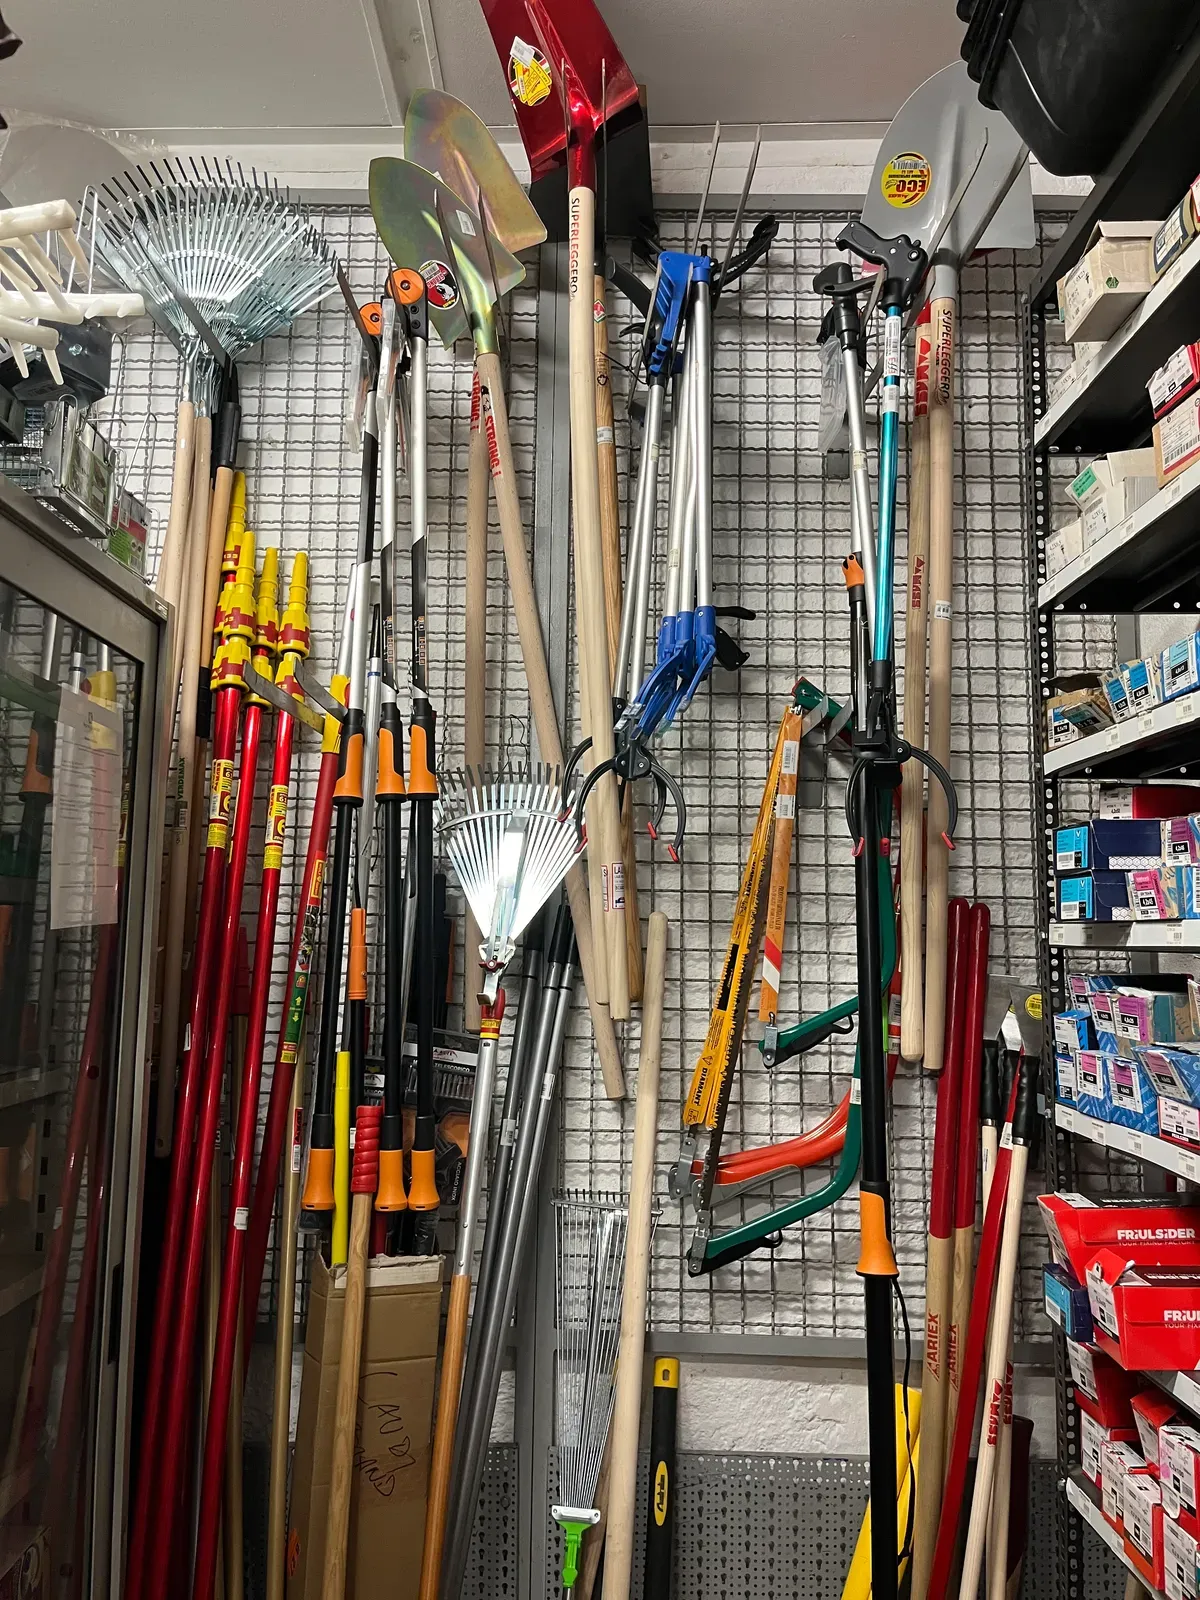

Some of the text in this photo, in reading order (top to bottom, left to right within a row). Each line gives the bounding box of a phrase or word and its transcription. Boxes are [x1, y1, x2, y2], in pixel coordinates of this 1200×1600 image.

[896, 179, 926, 193] ECO
[570, 197, 580, 293] SUPERLEGGERO
[940, 308, 953, 399] SUPERLEGGERO
[484, 415, 500, 469] STRONG
[176, 755, 186, 801] VERDEMAX
[434, 1062, 470, 1072] TELESCOPICO
[693, 1066, 708, 1107] DIAMANT
[453, 1161, 462, 1186] ACCIAIO
